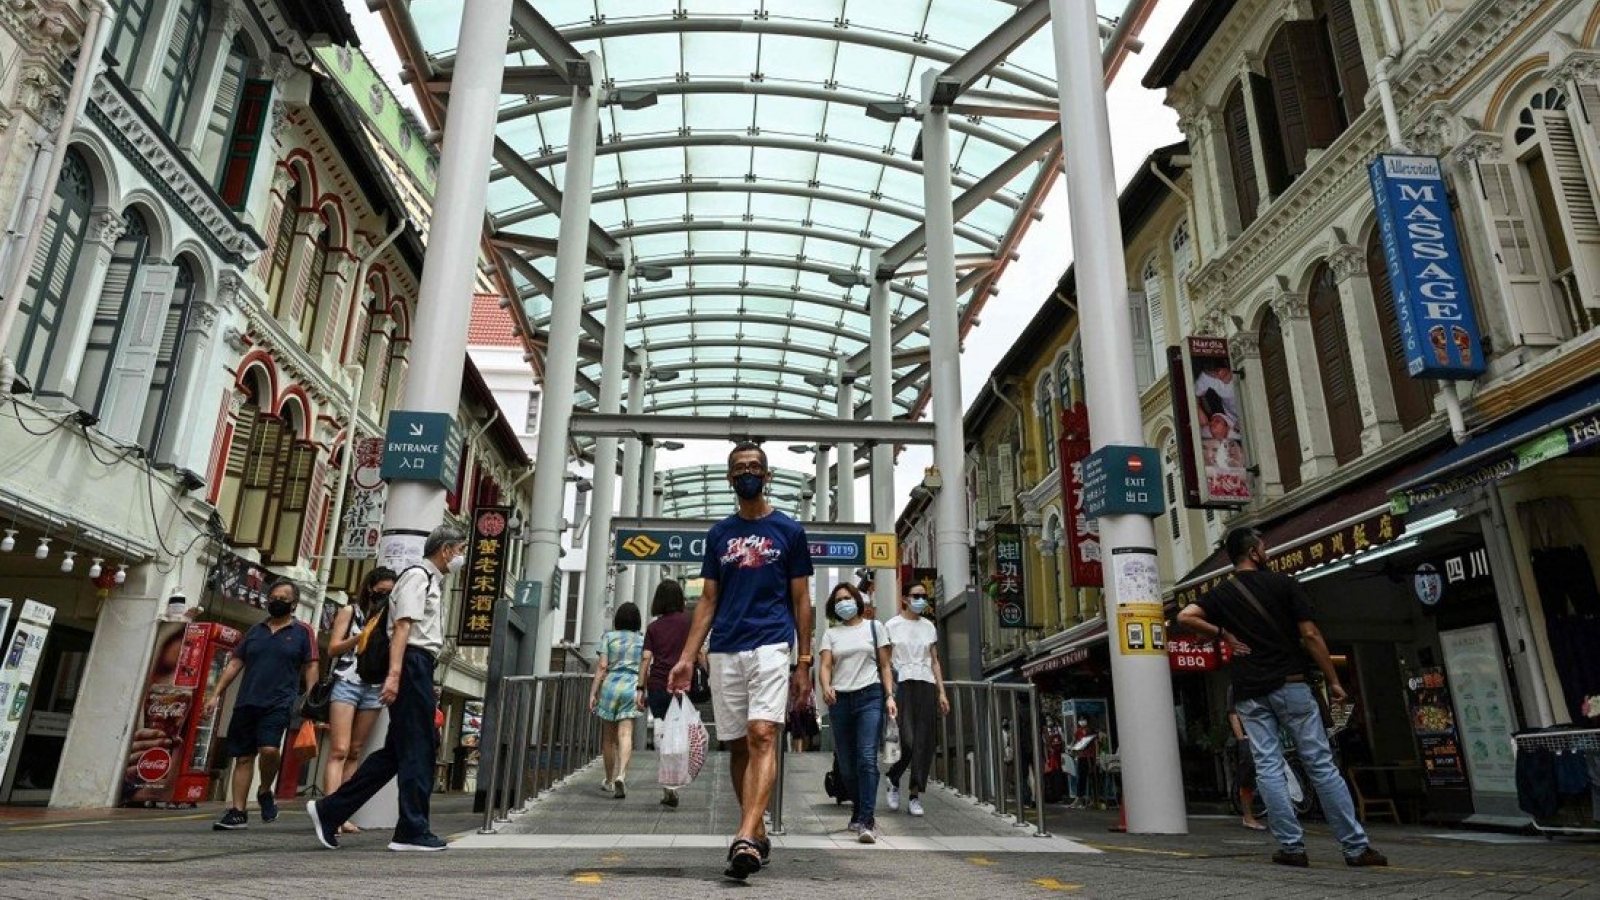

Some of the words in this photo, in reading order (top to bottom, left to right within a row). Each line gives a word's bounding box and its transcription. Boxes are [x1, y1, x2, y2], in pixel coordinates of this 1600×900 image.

[1396, 183, 1462, 321] MASSAGE
[1398, 290, 1416, 350] 4546
[388, 442, 439, 454] ENTRANCE
[399, 456, 425, 469] 入口
[1124, 477, 1145, 487] EXIT
[1125, 491, 1148, 503] 出口
[829, 544, 855, 556] DT19
[875, 546, 886, 558] A
[1444, 548, 1490, 585] 四川
[1177, 656, 1207, 669] BBQ
